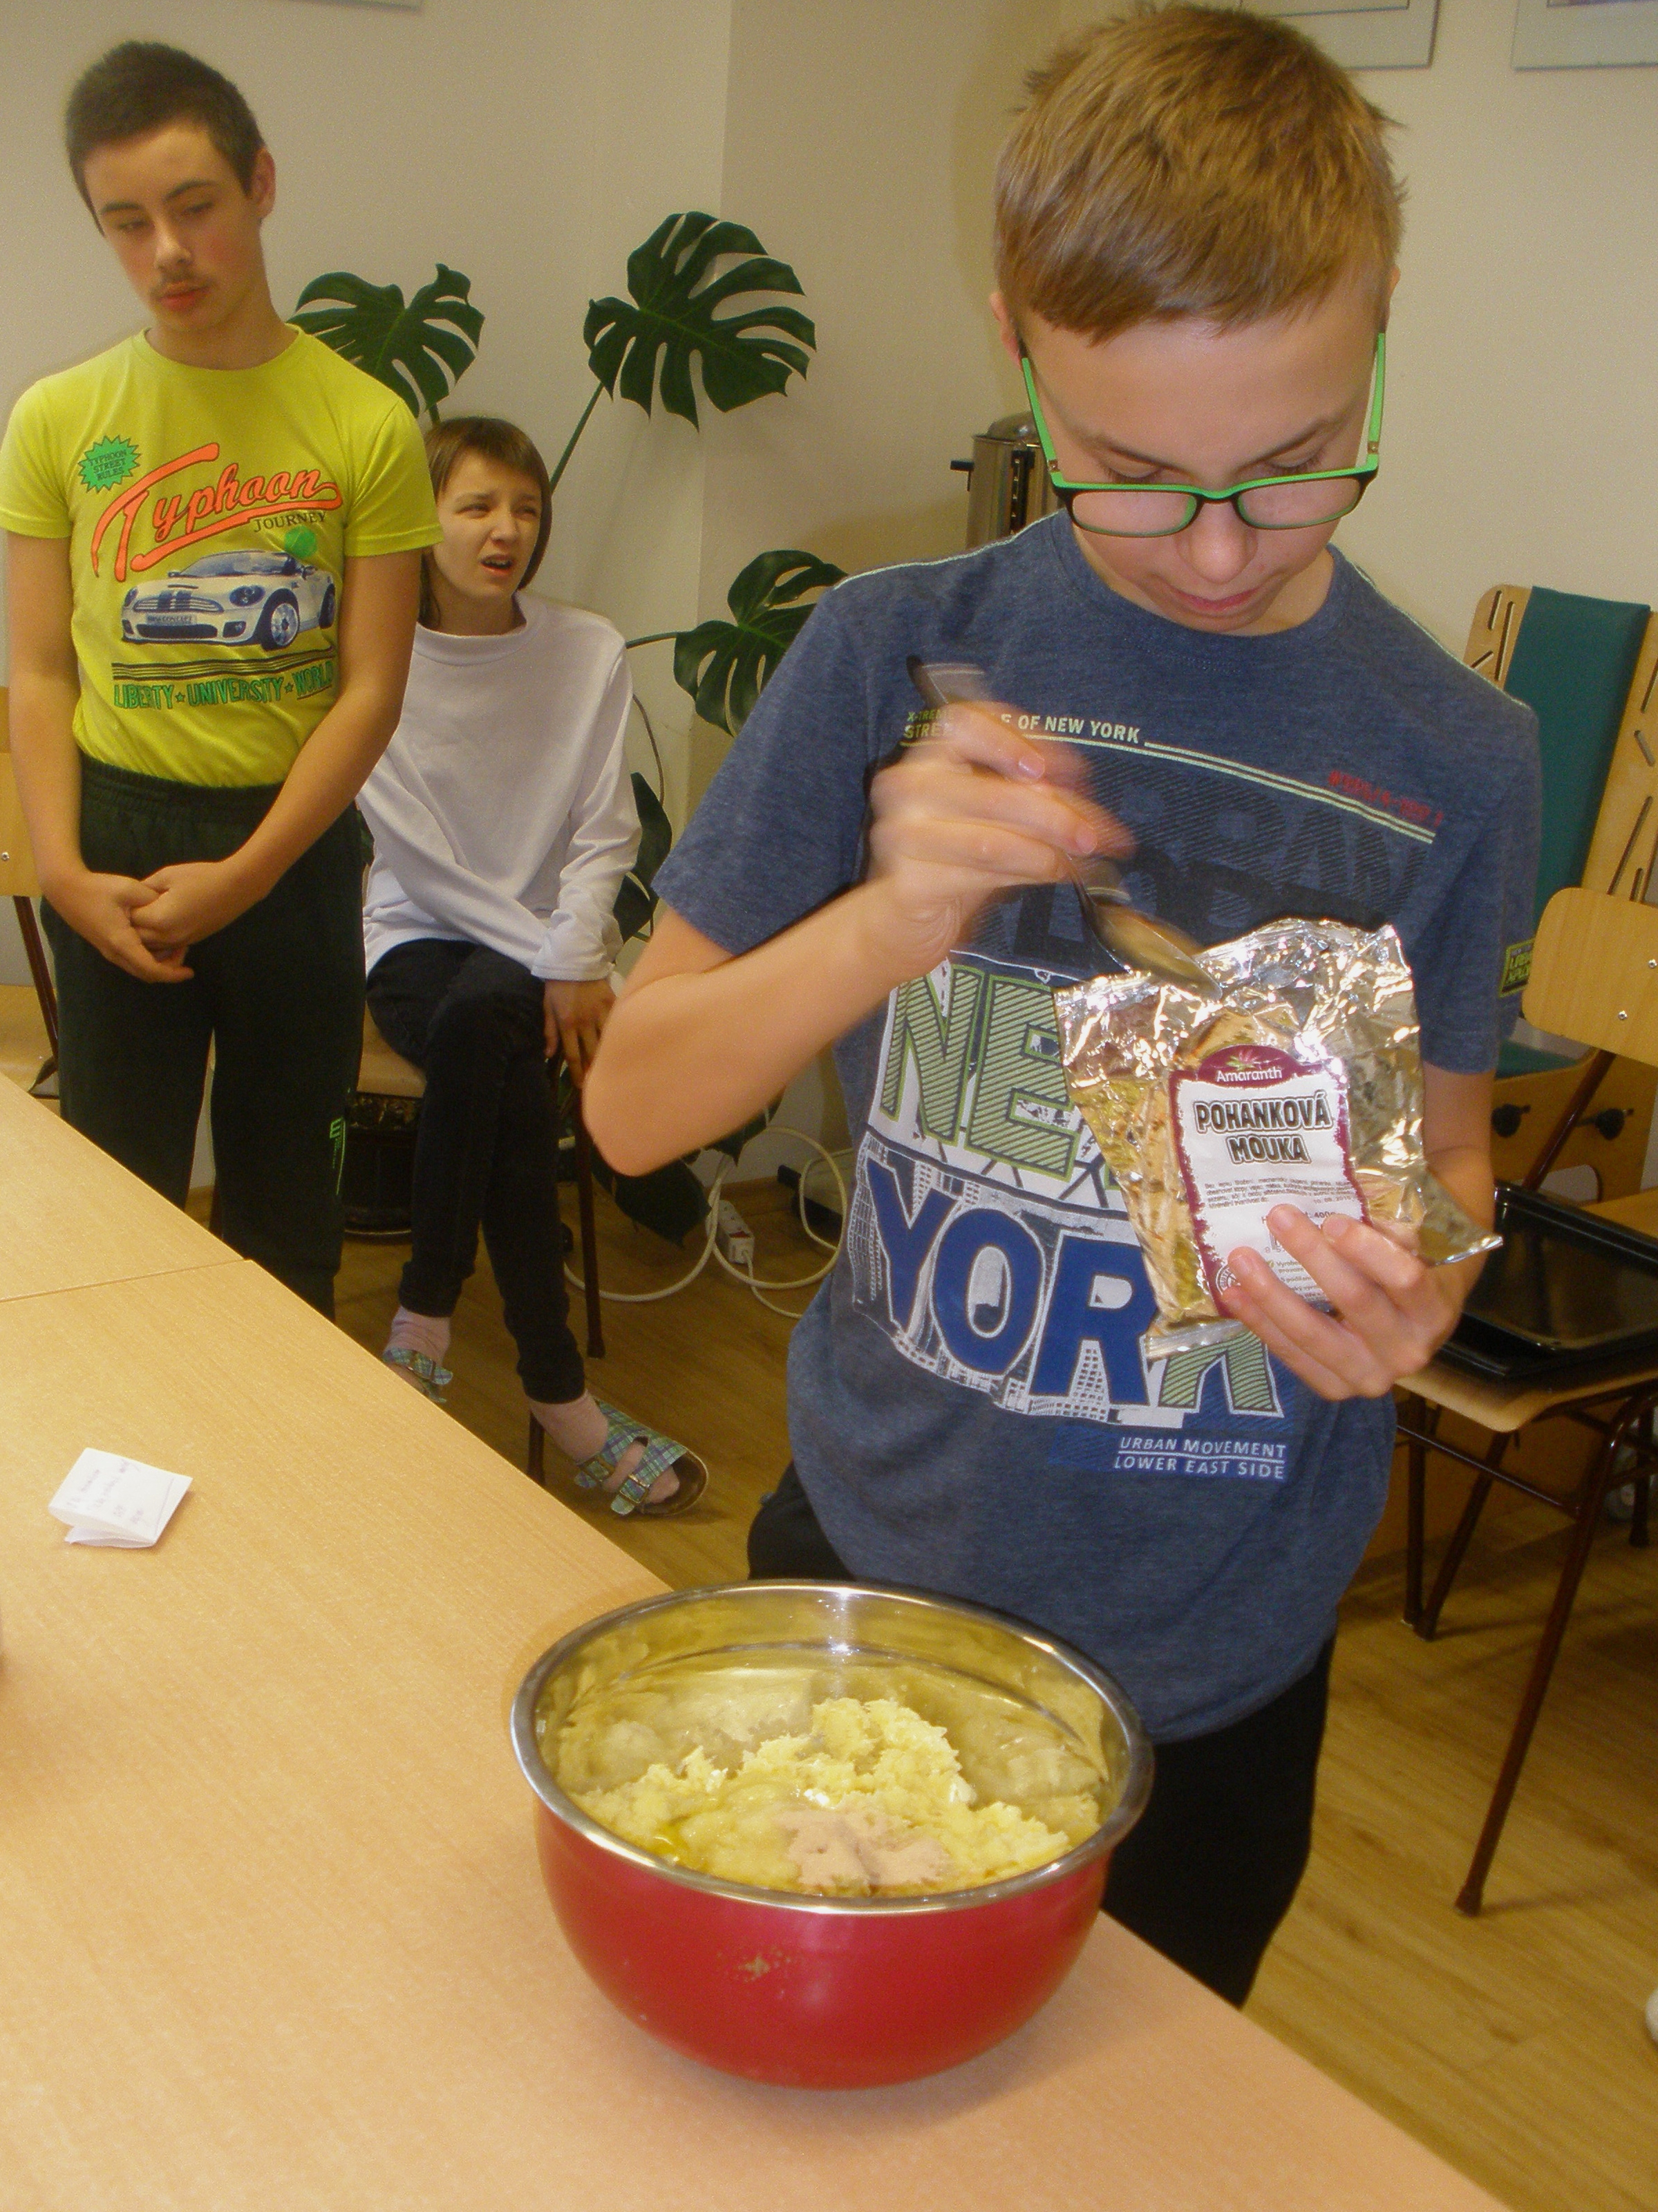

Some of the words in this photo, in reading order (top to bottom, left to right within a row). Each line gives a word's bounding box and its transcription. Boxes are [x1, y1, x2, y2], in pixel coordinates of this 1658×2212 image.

[91, 442, 343, 582] Typhoon
[253, 511, 326, 532] JOURNEY
[113, 683, 174, 710] LIBERTY
[186, 677, 284, 706] UNIVERSITY
[903, 722, 952, 739] STRE
[1017, 715, 1040, 730] OF
[1045, 715, 1084, 735] NEW
[1090, 720, 1141, 744] YORK
[907, 709, 943, 722] X-TRE
[880, 964, 1080, 1183] NE
[1216, 1067, 1283, 1083] Amaranth
[1194, 1090, 1334, 1134] POHANKOVÁ
[1225, 1134, 1312, 1165] MOUKA
[1120, 1436, 1178, 1451] URBAN
[1183, 1438, 1287, 1459] MOVEMENT
[1114, 1456, 1177, 1471] LOWER
[1185, 1460, 1230, 1475] EAST
[1238, 1462, 1285, 1480] SIDE
